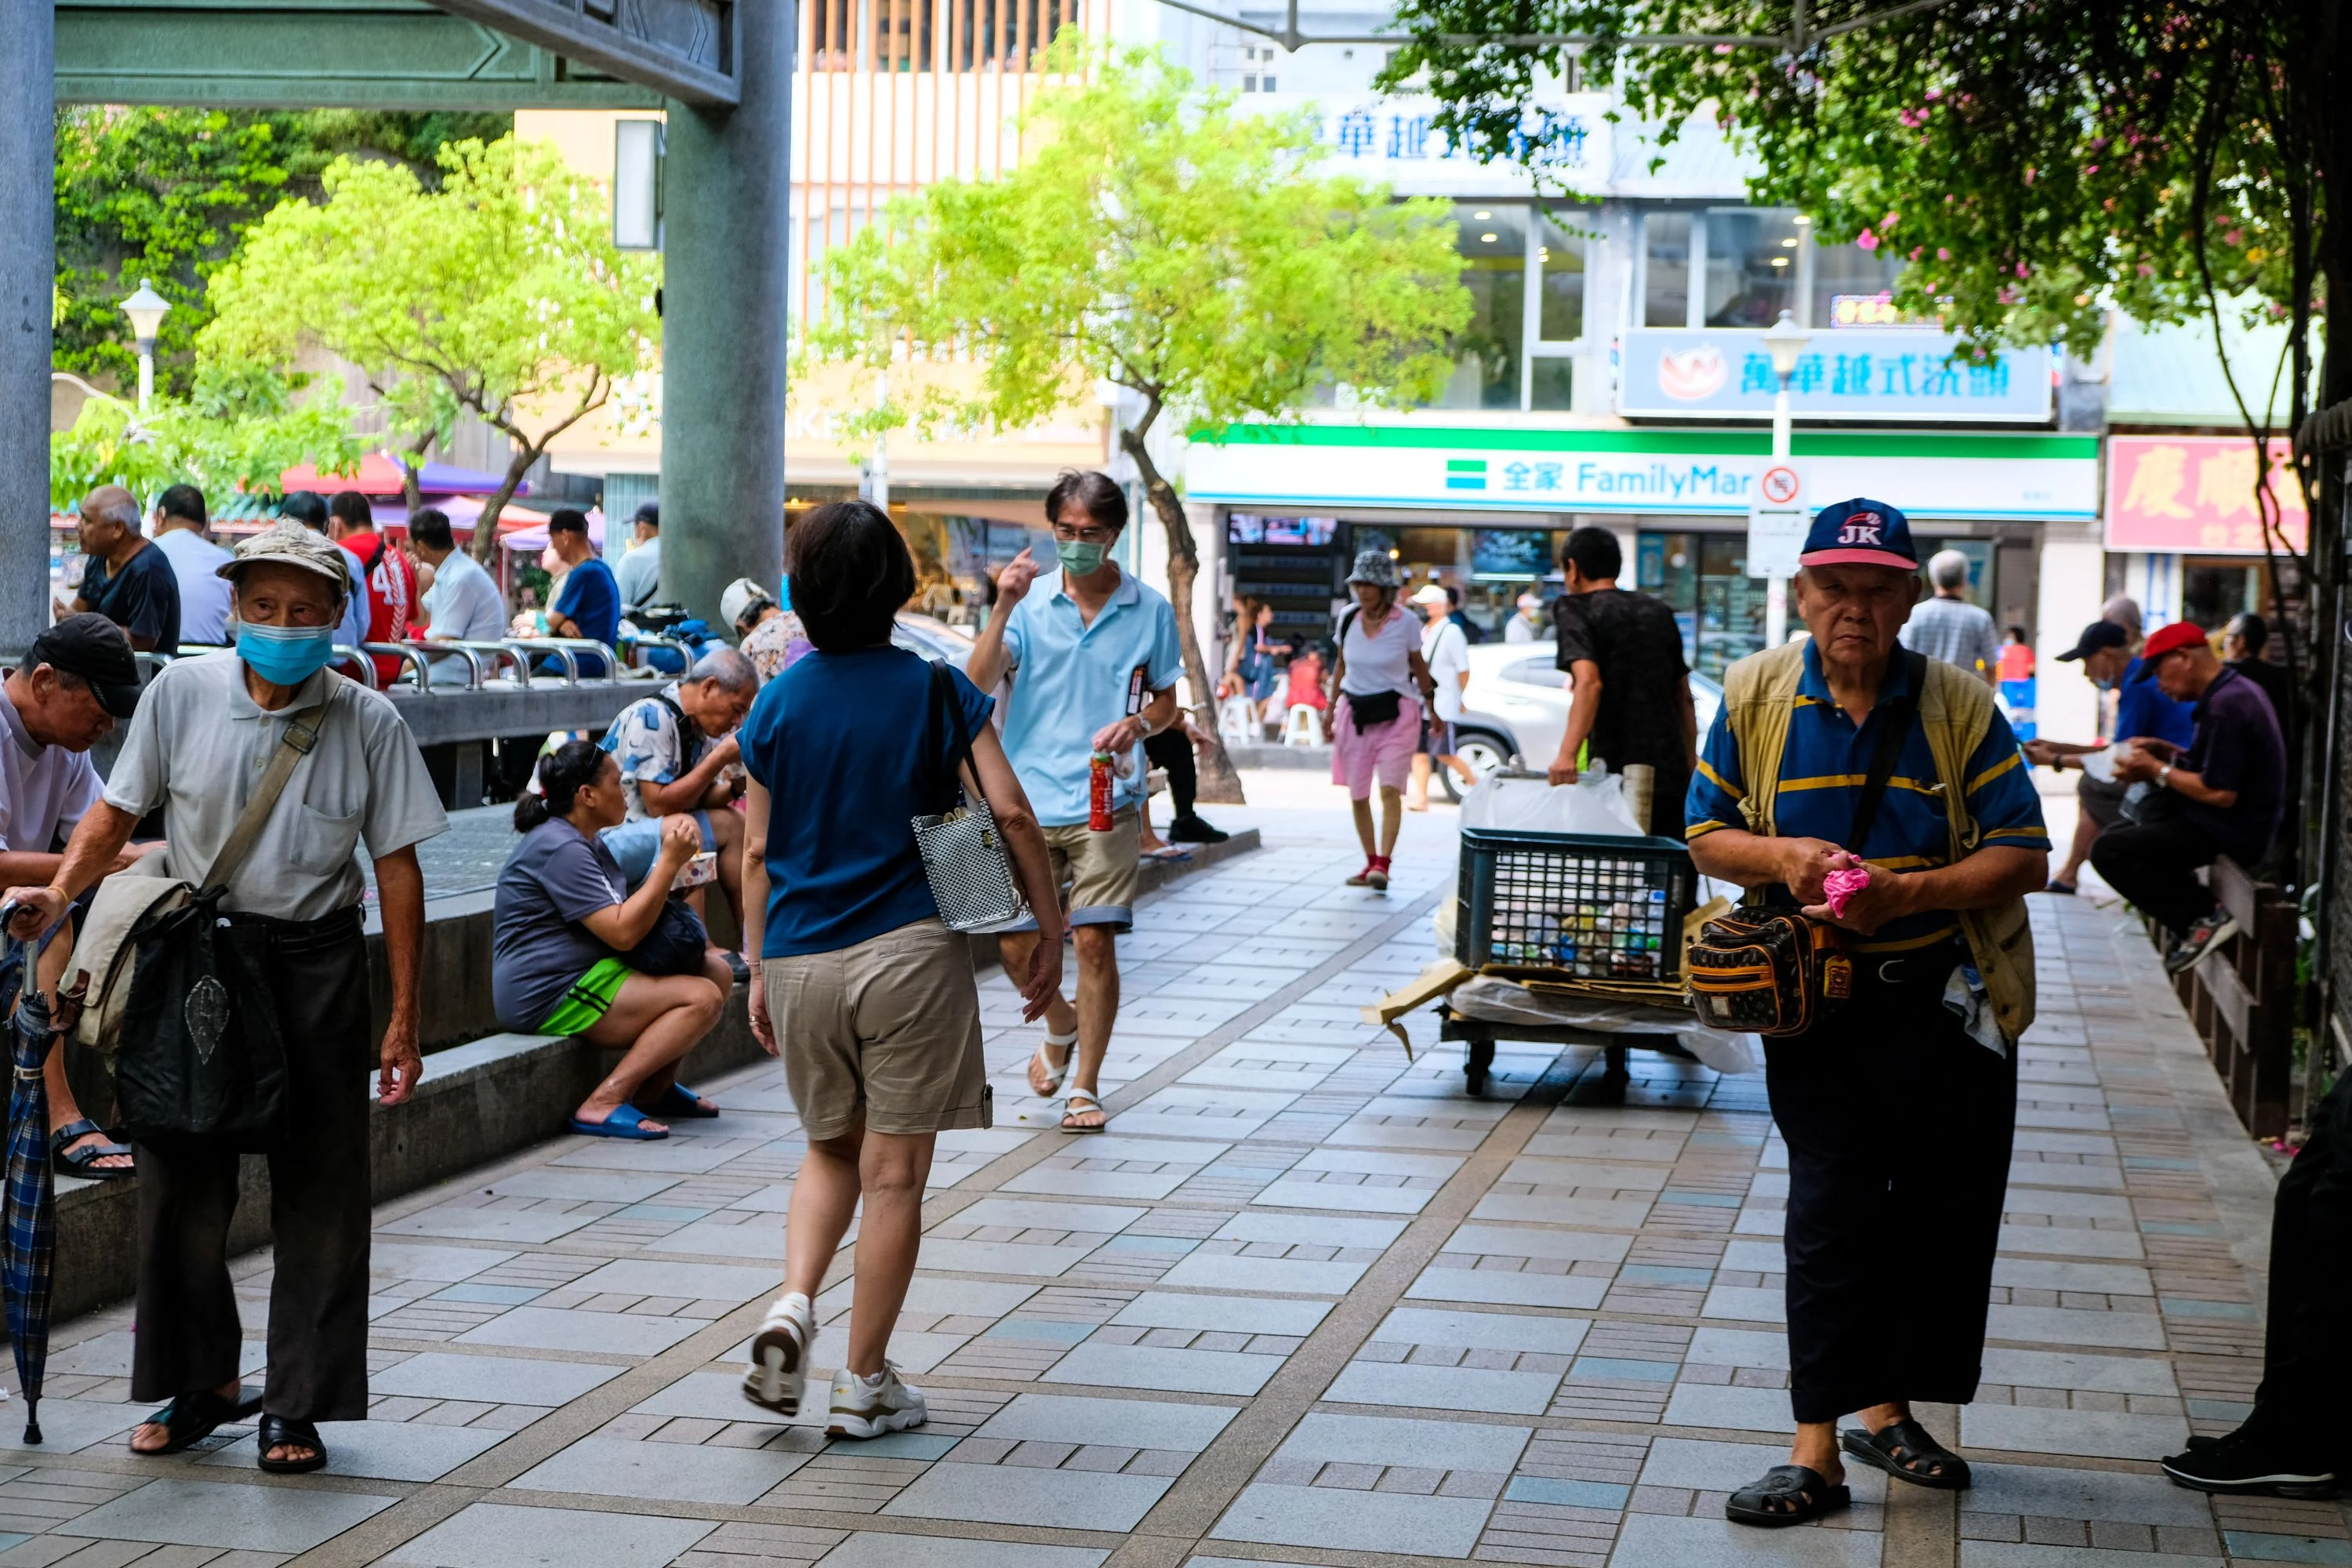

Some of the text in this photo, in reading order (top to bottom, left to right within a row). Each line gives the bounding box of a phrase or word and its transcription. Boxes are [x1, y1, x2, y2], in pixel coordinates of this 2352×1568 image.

[1502, 461, 1753, 499] 全家 FamilyMar
[1837, 525, 1882, 546] JK
